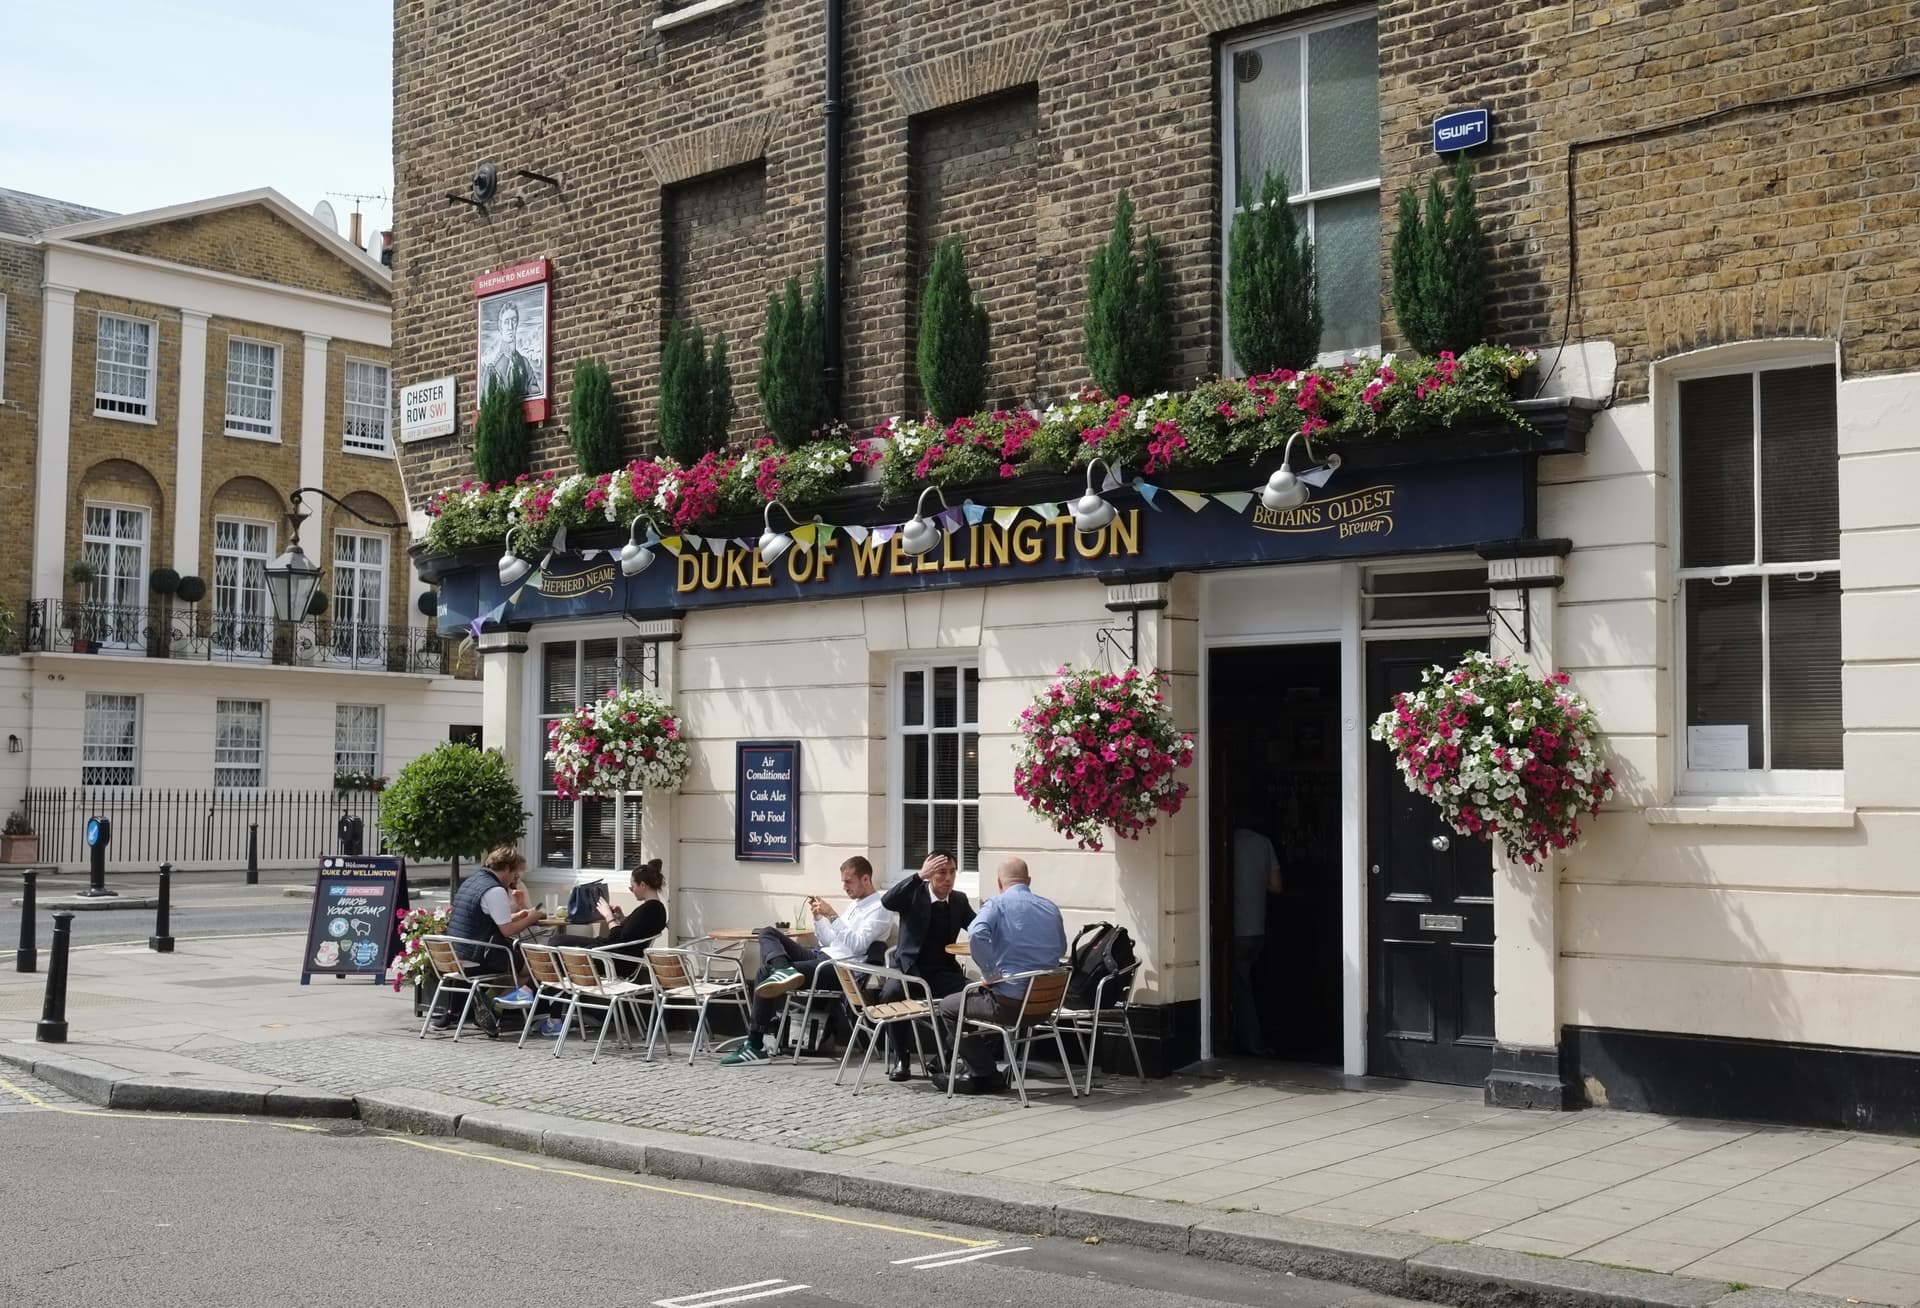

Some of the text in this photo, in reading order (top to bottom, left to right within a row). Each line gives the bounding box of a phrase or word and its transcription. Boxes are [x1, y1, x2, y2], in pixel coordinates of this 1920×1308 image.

[1438, 121, 1484, 140] SWIFT
[479, 266, 540, 288] SHEPHERD NEAME
[407, 385, 443, 406] CHESTER
[407, 401, 447, 424] ROW SW1
[1328, 489, 1395, 521] OLDEST
[1339, 518, 1385, 539] Brewer
[677, 509, 1139, 592] DUKE OF WELLINGTON
[543, 567, 616, 593] HEPHERD NEAME
[761, 756, 776, 767] Air
[746, 768, 791, 780] Conditioned
[750, 790, 786, 801] Cask Ales
[751, 810, 786, 822] Pub Food
[748, 831, 787, 846] Sky Sports
[352, 869, 397, 877] WELLINGTON
[326, 905, 386, 918] YOUR TEAM?
